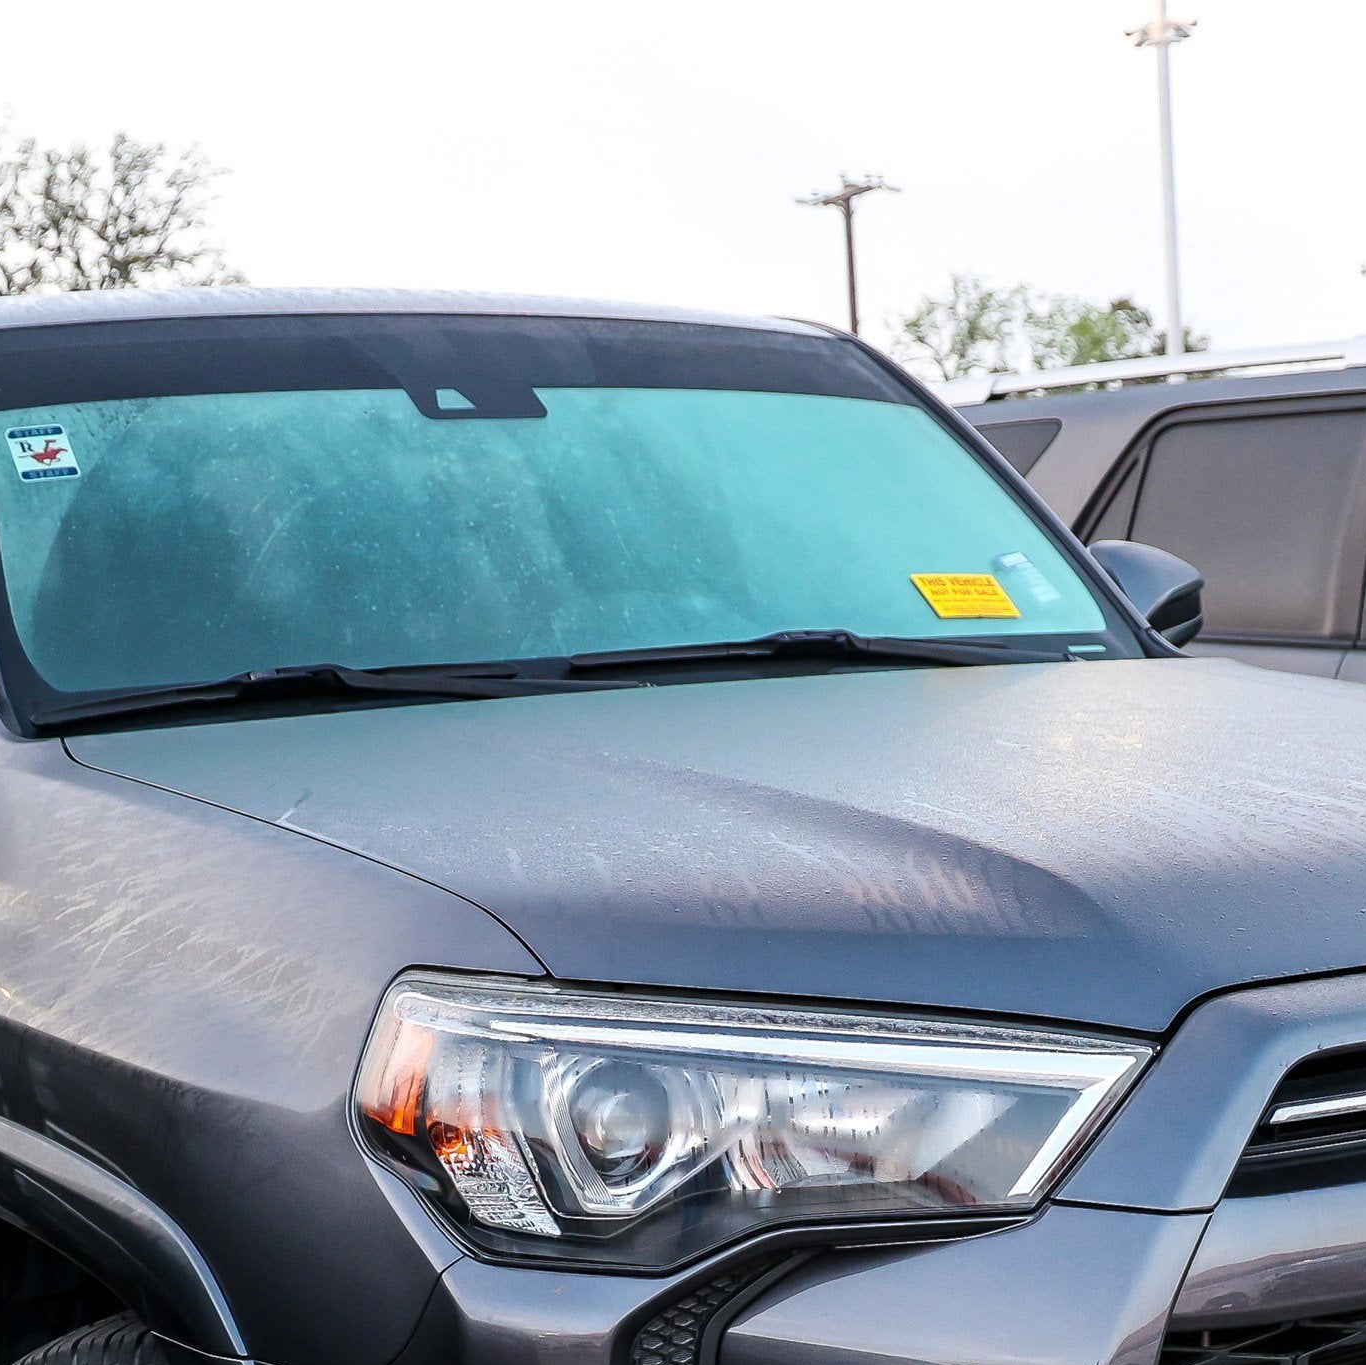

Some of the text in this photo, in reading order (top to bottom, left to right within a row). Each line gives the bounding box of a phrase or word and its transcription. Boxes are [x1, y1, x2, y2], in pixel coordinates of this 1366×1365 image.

[918, 577, 995, 587] THIS VEHICLE
[931, 588, 999, 596] NOT FOR SALE
